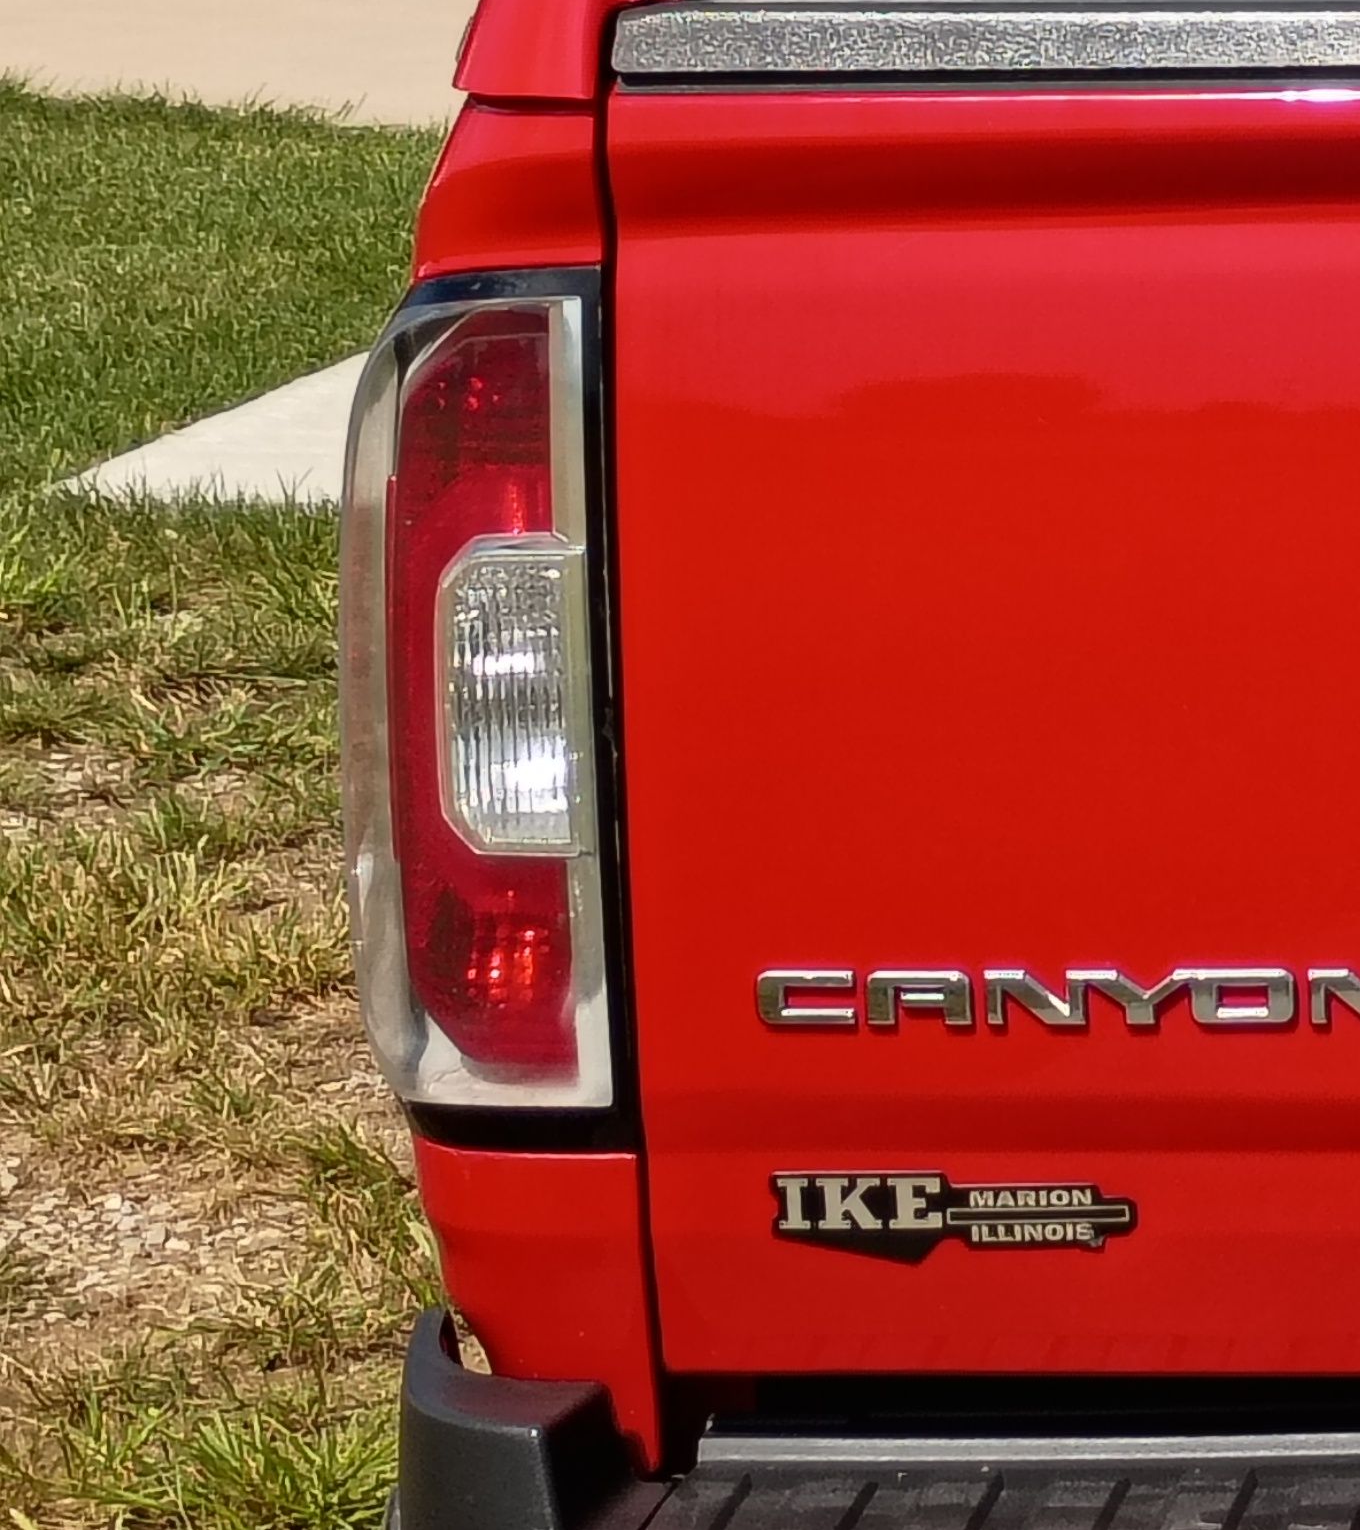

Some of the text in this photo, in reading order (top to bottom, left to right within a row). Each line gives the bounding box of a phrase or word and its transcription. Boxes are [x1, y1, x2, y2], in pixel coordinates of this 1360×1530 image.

[776, 1177, 943, 1230] IKE
[969, 1189, 1092, 1208] MARION
[971, 1223, 1095, 1242] ILLINOIS
